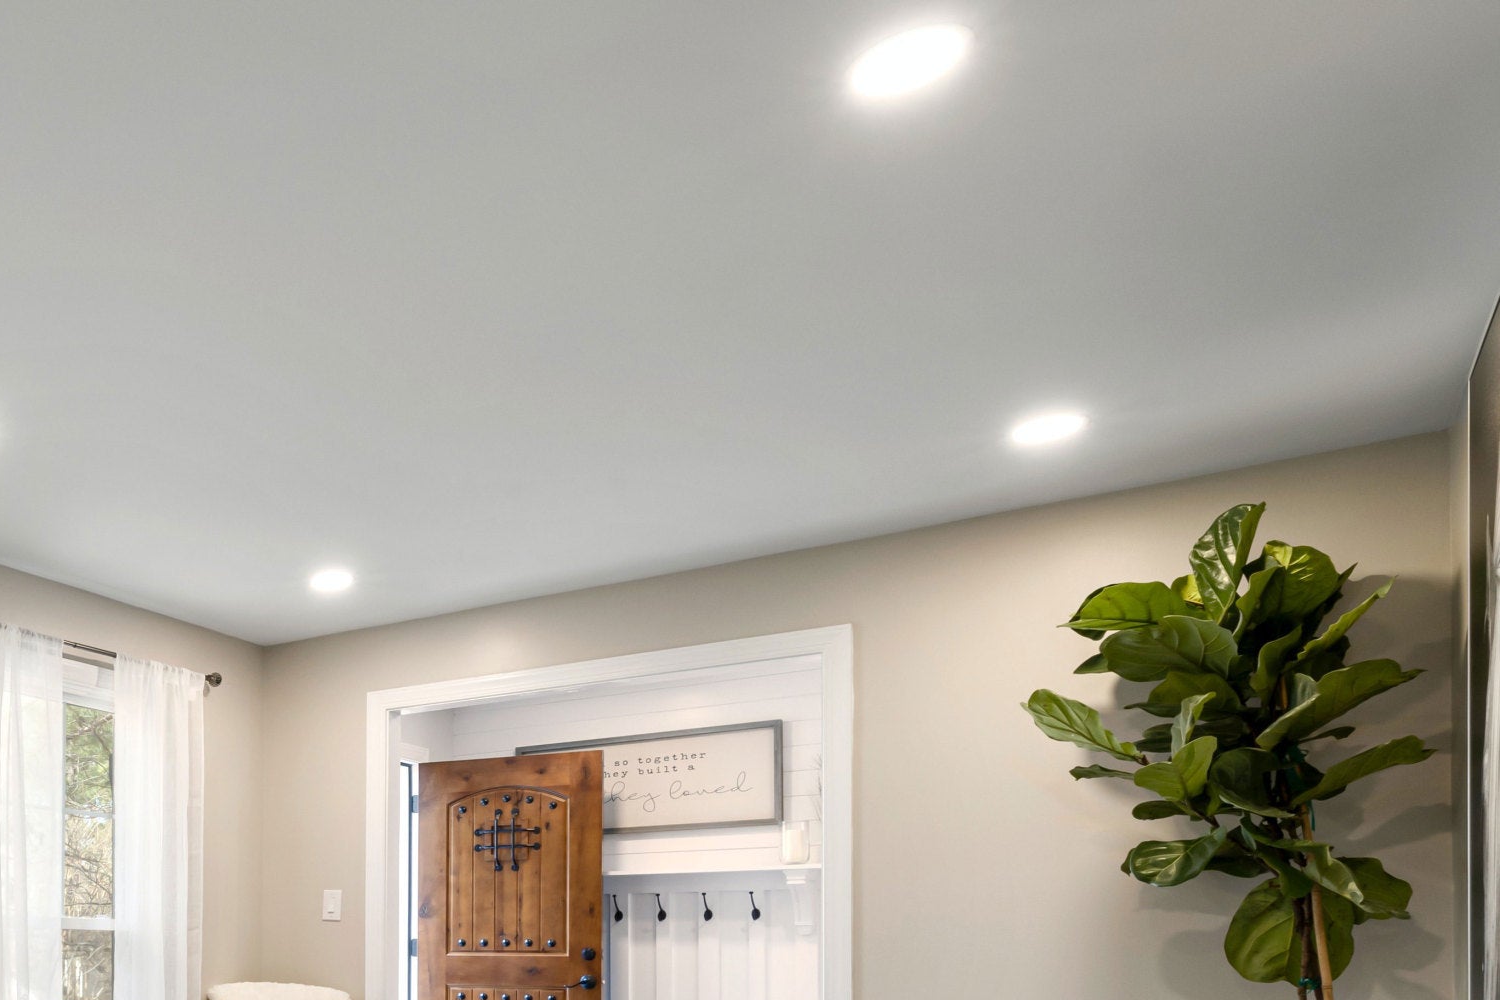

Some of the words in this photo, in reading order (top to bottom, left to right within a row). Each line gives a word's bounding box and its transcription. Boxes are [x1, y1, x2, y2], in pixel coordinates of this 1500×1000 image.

[638, 752, 706, 765] together
[604, 771, 628, 779] hey
[637, 766, 678, 775] built
[604, 781, 661, 812] hey
[668, 770, 754, 800] loved
